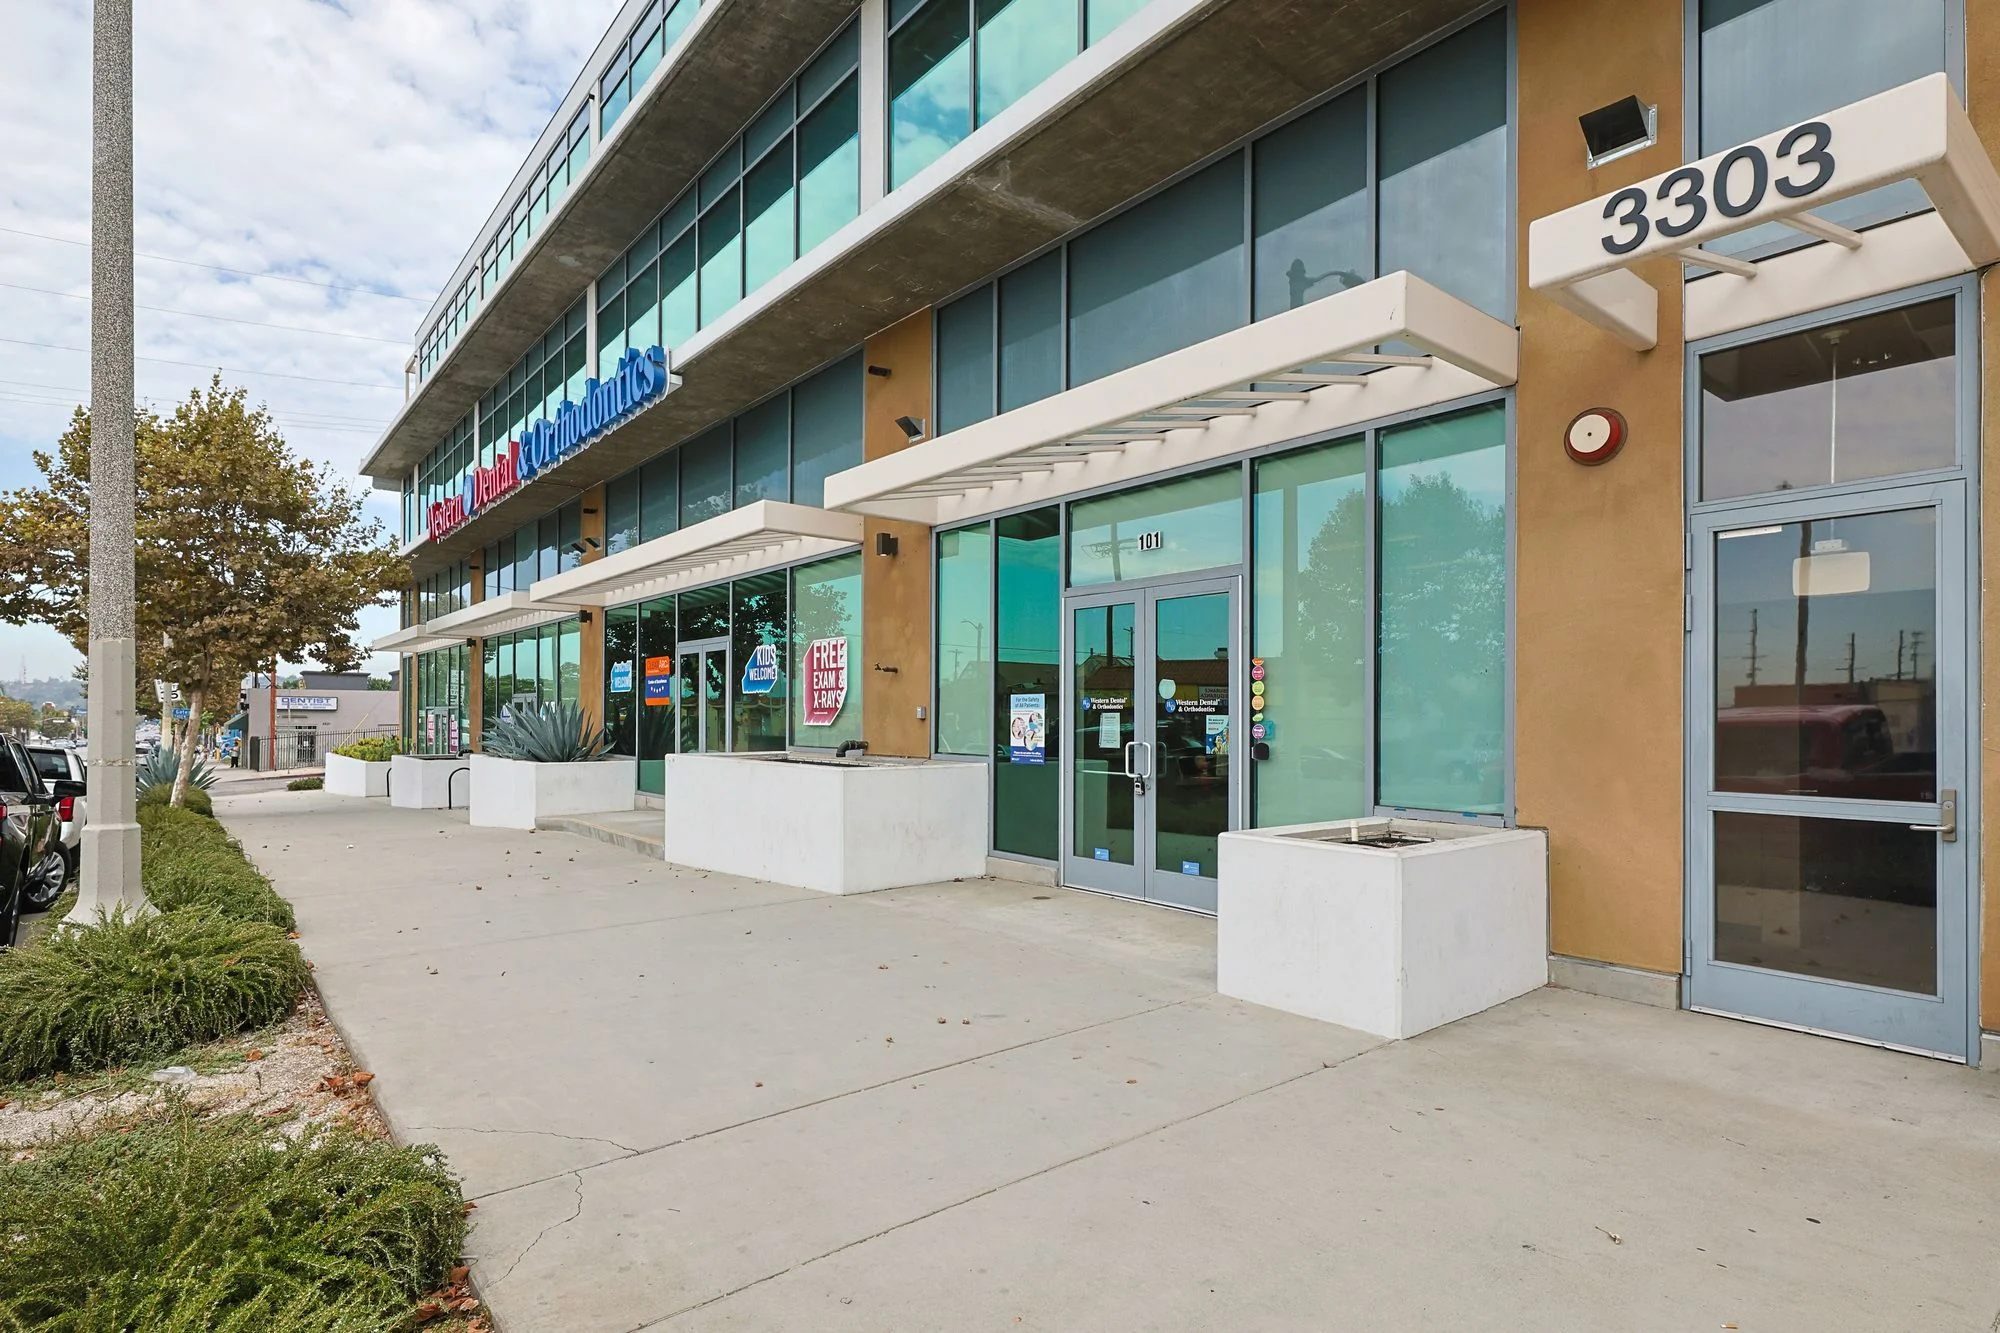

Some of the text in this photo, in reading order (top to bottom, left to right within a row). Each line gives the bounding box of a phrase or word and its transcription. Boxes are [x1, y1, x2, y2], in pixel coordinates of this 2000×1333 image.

[1602, 121, 1836, 254] 3303
[427, 494, 463, 540] Western
[473, 441, 519, 511] Dental
[516, 431, 536, 480] &
[531, 345, 665, 470] Orthodontics
[1139, 532, 1160, 550] 101
[756, 645, 776, 666] KIDS
[813, 639, 846, 669] FREE
[813, 670, 845, 689] EXAM &
[813, 689, 841, 709] X-RAYS
